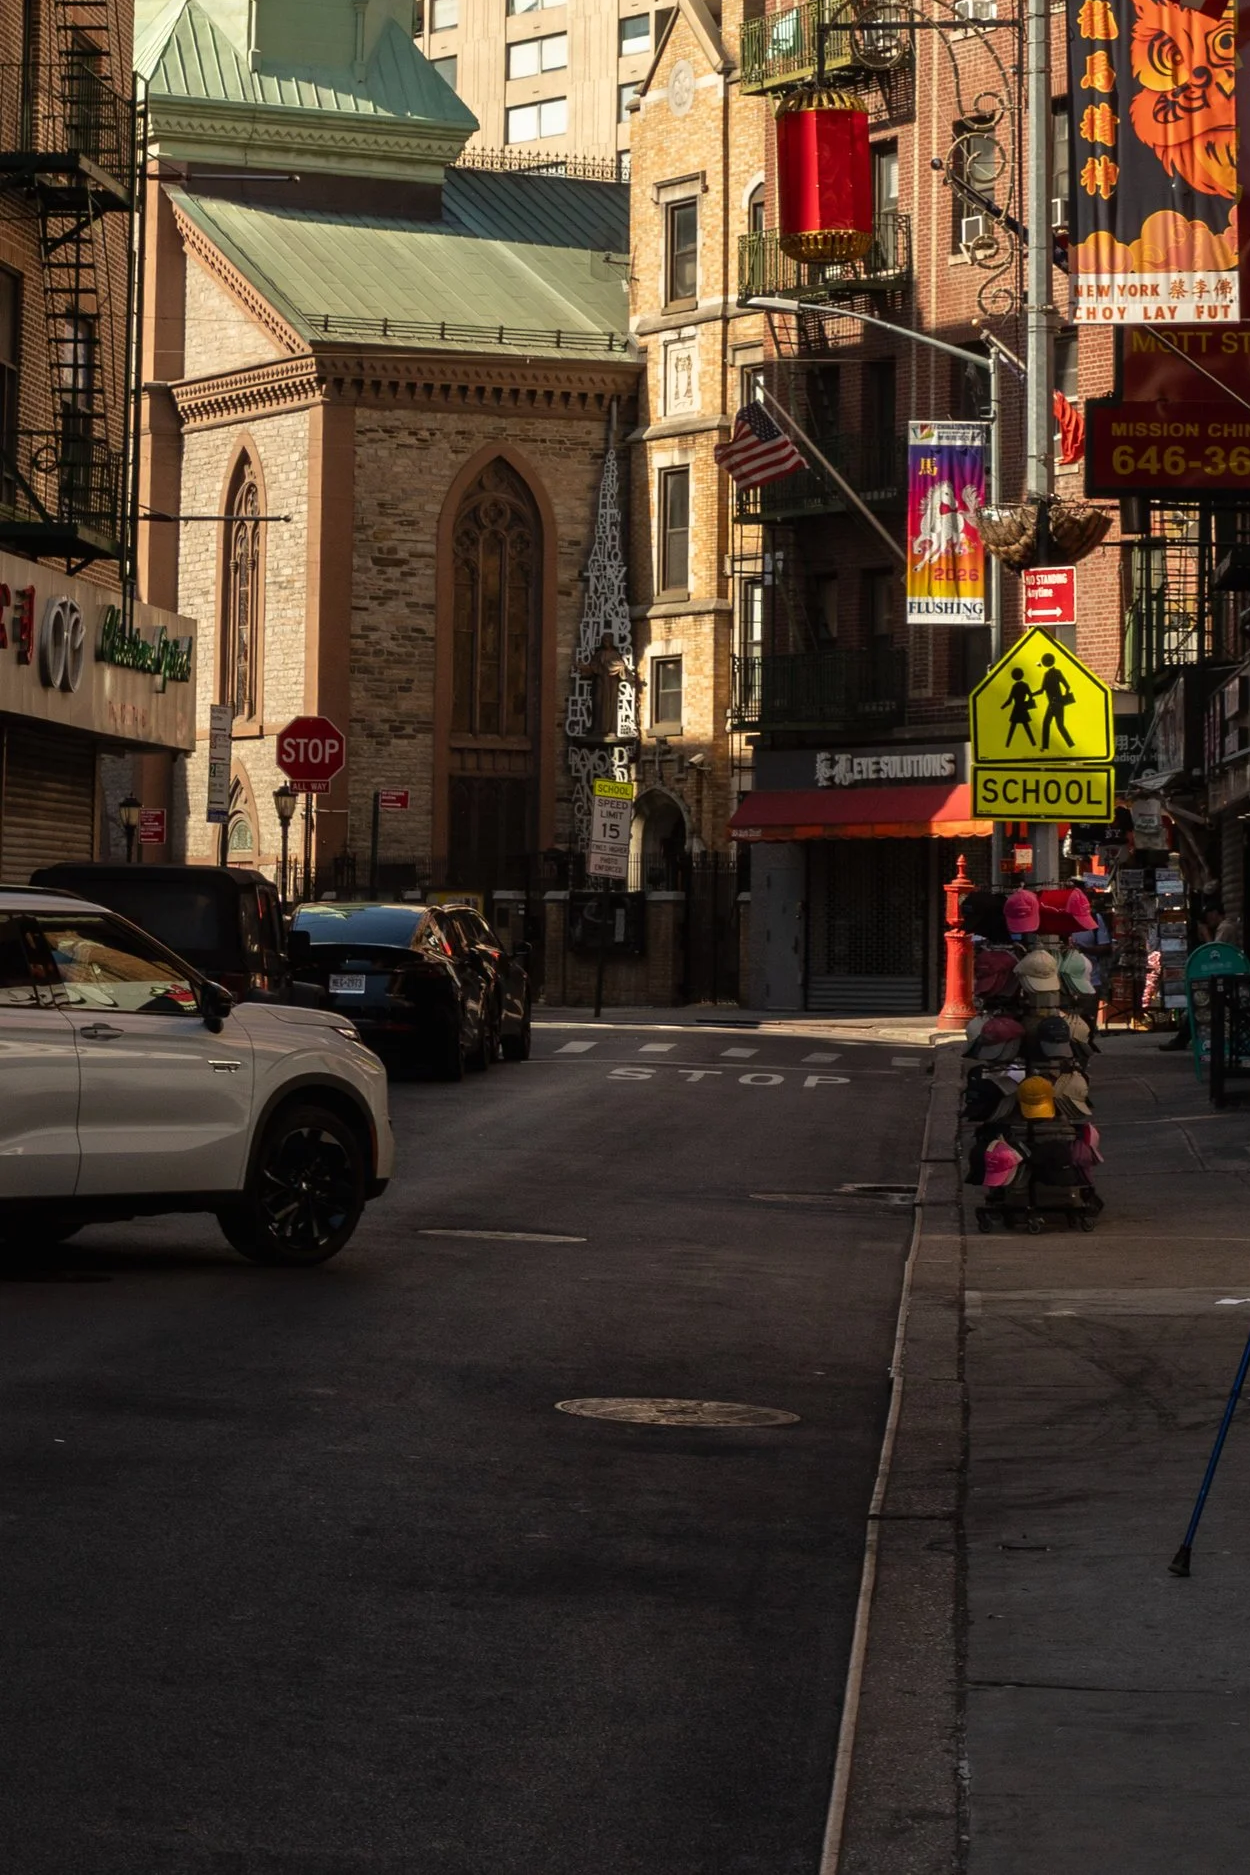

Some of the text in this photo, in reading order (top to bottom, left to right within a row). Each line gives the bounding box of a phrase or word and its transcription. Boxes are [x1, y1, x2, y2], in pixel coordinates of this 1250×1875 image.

[1074, 283, 1160, 298] NEW YORK
[1168, 278, 1234, 301] 蔡李佛
[1074, 304, 1231, 320] CHOY LAY FUT
[1131, 330, 1213, 355] MOTT
[1111, 421, 1199, 437] MISSION
[919, 457, 938, 476] 馬
[934, 567, 979, 582] 2026
[1036, 573, 1068, 585] STANDING
[908, 601, 984, 615] FLUSHING
[281, 738, 340, 765] STOP
[852, 757, 880, 780] EYE
[880, 753, 956, 779] SOLUTIONS
[292, 781, 328, 792] ALL WAY
[597, 783, 630, 796] SCHOOL
[981, 777, 1103, 805] SCHOOL
[598, 798, 629, 810] SPEED
[600, 810, 624, 820] LIMIT
[602, 823, 620, 839] 15
[606, 1067, 851, 1088] STOP
